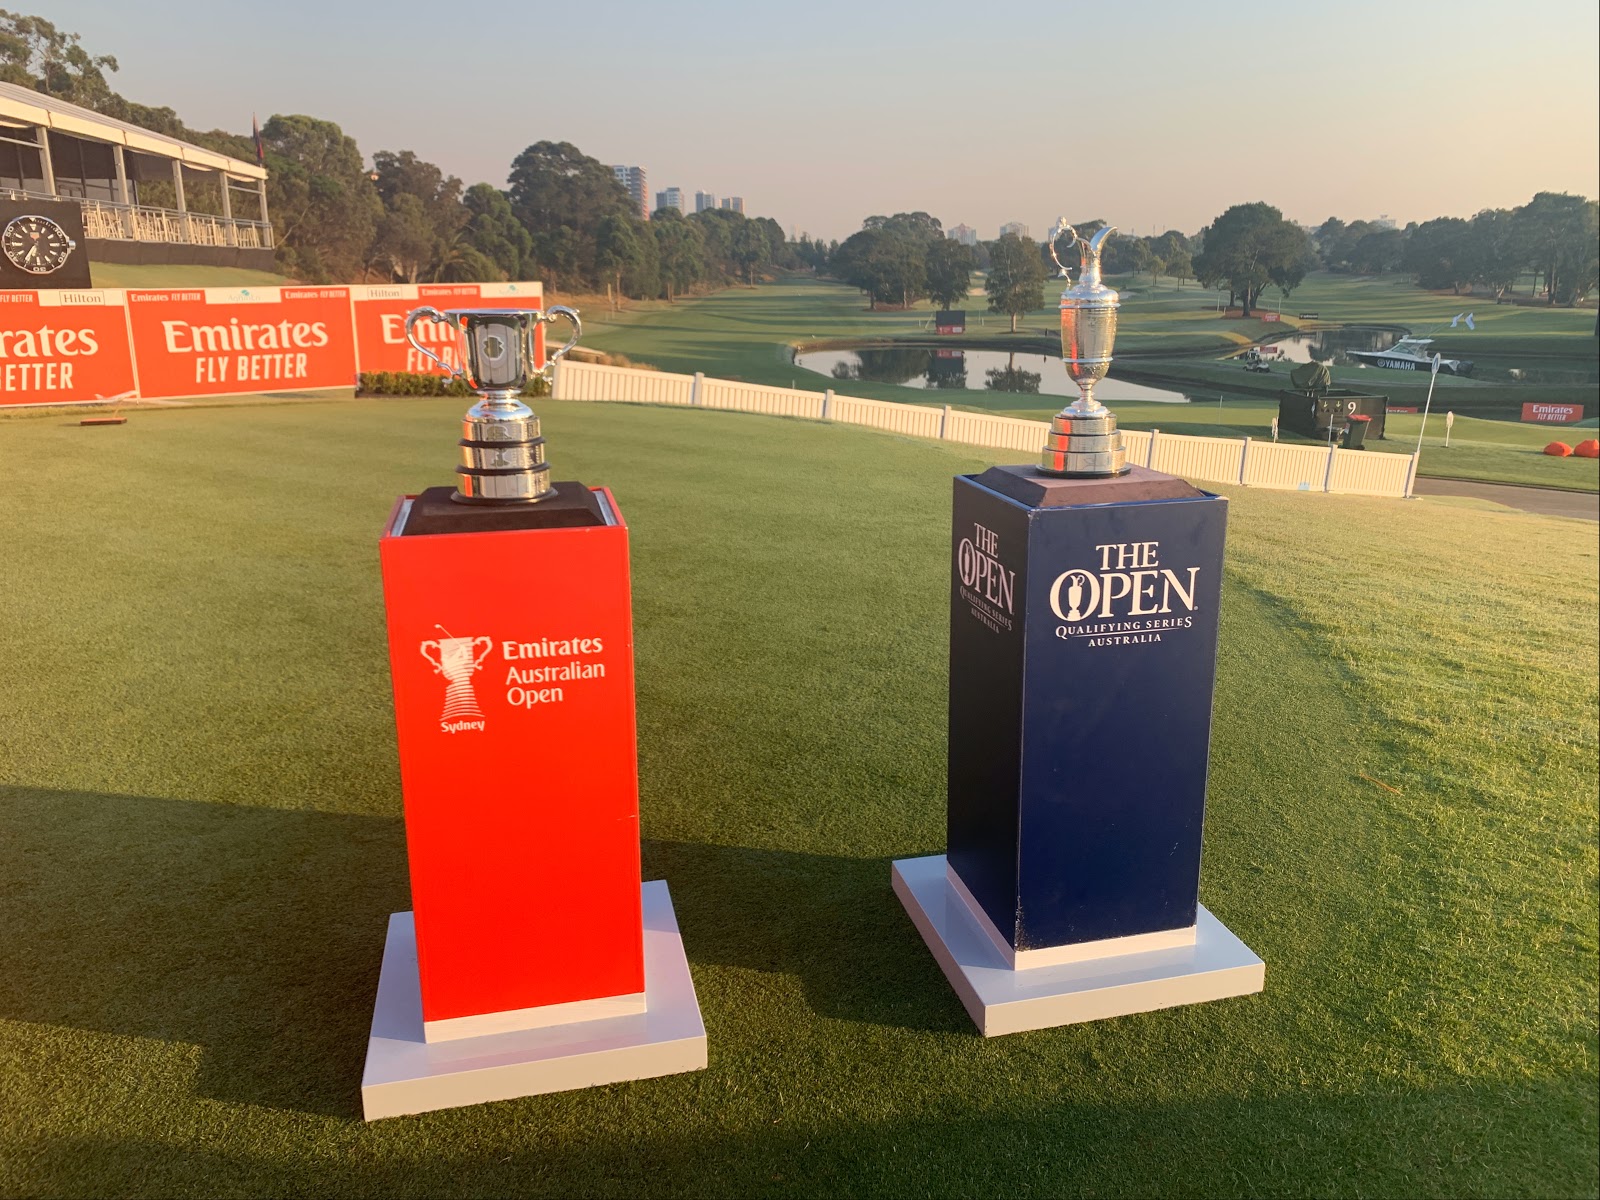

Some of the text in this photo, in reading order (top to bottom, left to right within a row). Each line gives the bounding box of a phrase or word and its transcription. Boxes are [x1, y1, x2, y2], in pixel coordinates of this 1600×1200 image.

[11, 294, 34, 303] BETTER
[63, 293, 102, 303] Hilton
[131, 293, 169, 302] Emirates
[181, 292, 200, 301] BETTER
[284, 290, 318, 299] Emirates
[370, 288, 400, 298] Hilton
[161, 317, 329, 352] Emirates
[0, 362, 73, 391] ETTER
[195, 353, 308, 383] FLY BETTER
[1385, 360, 1416, 371] YAMAHA
[1347, 401, 1357, 416] 9
[1532, 404, 1574, 414] Emirates
[974, 522, 999, 559] THE
[1095, 541, 1159, 571] THE
[958, 537, 1016, 616] OPEN
[1049, 566, 1201, 622] OPEN
[1055, 616, 1192, 640] QUALIFYING SERIES
[502, 637, 603, 660] Emirates
[1088, 633, 1162, 647] AUSTRALIA
[505, 661, 606, 686] Australian
[506, 686, 563, 710] Open
[440, 720, 486, 734] Sydney
